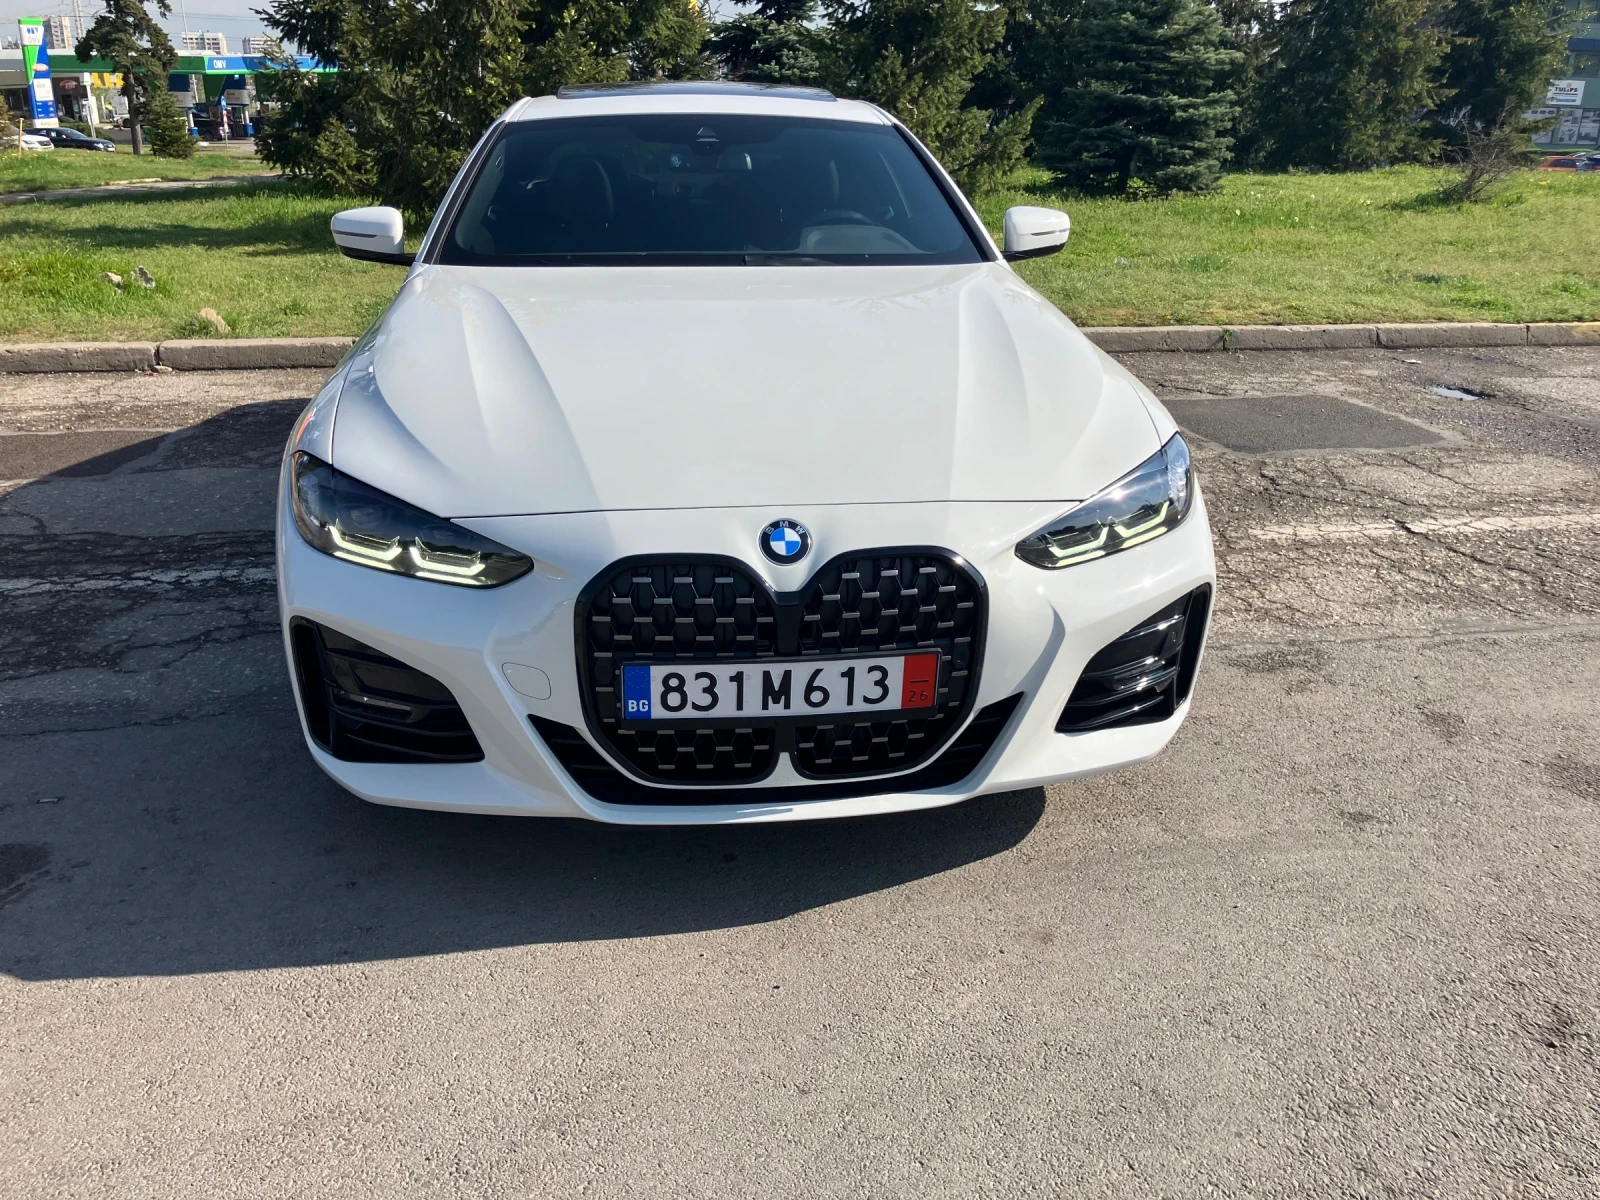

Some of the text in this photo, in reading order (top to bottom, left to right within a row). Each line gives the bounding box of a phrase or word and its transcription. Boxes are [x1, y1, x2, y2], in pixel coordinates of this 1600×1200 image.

[213, 60, 227, 68] OMV
[765, 520, 806, 535] BMW
[908, 689, 929, 703] 26
[628, 699, 649, 712] BG
